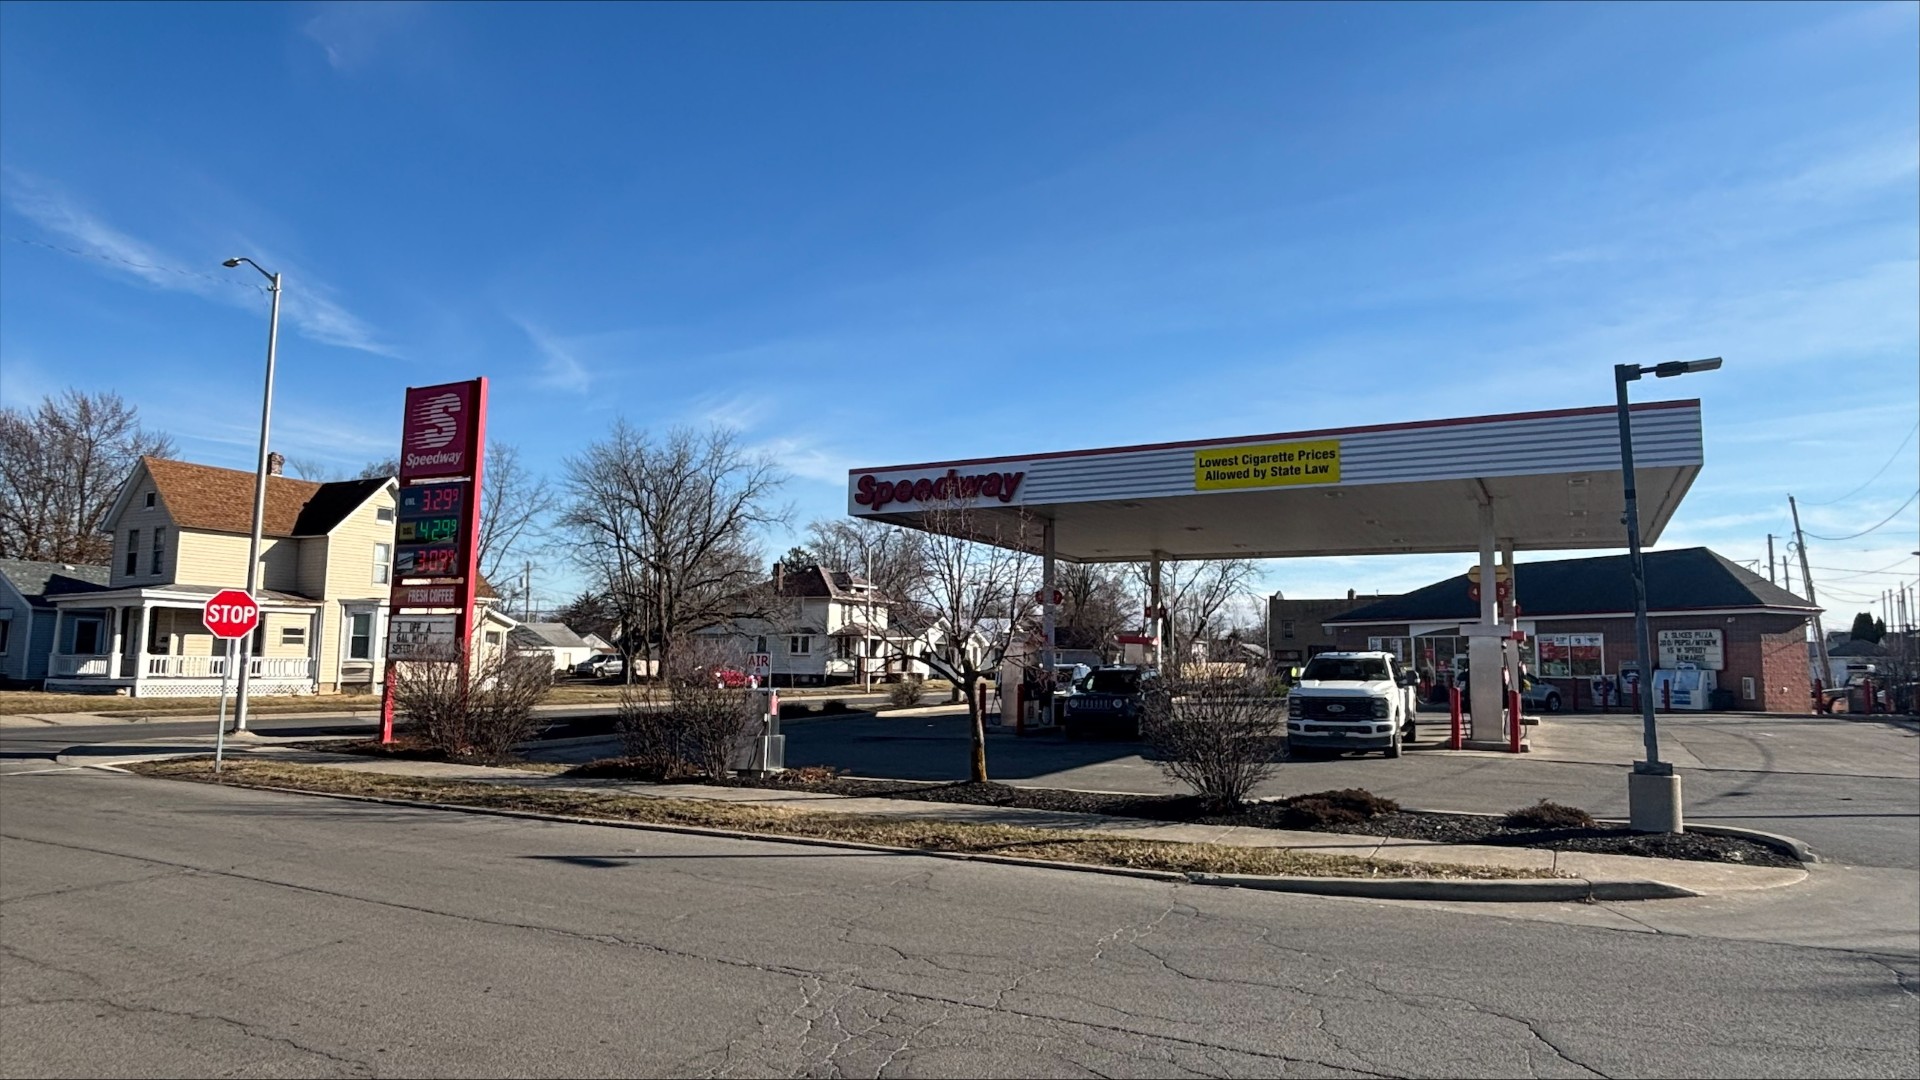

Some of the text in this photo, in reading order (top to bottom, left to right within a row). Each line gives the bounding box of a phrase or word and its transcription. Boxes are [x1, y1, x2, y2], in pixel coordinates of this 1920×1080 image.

[405, 450, 463, 469] Speedway
[1199, 449, 1336, 468] Lowest Cigarette Prices
[1205, 464, 1329, 481] Allowed by State Law
[854, 468, 1026, 511] Speedway
[408, 588, 455, 603] FRESH COFFEE
[1472, 588, 1478, 596] 4
[1500, 587, 1505, 595] 3
[207, 604, 256, 624] STOP
[427, 621, 432, 633] A
[1684, 646, 1706, 654] SPEEDY
[748, 655, 769, 667] AIR
